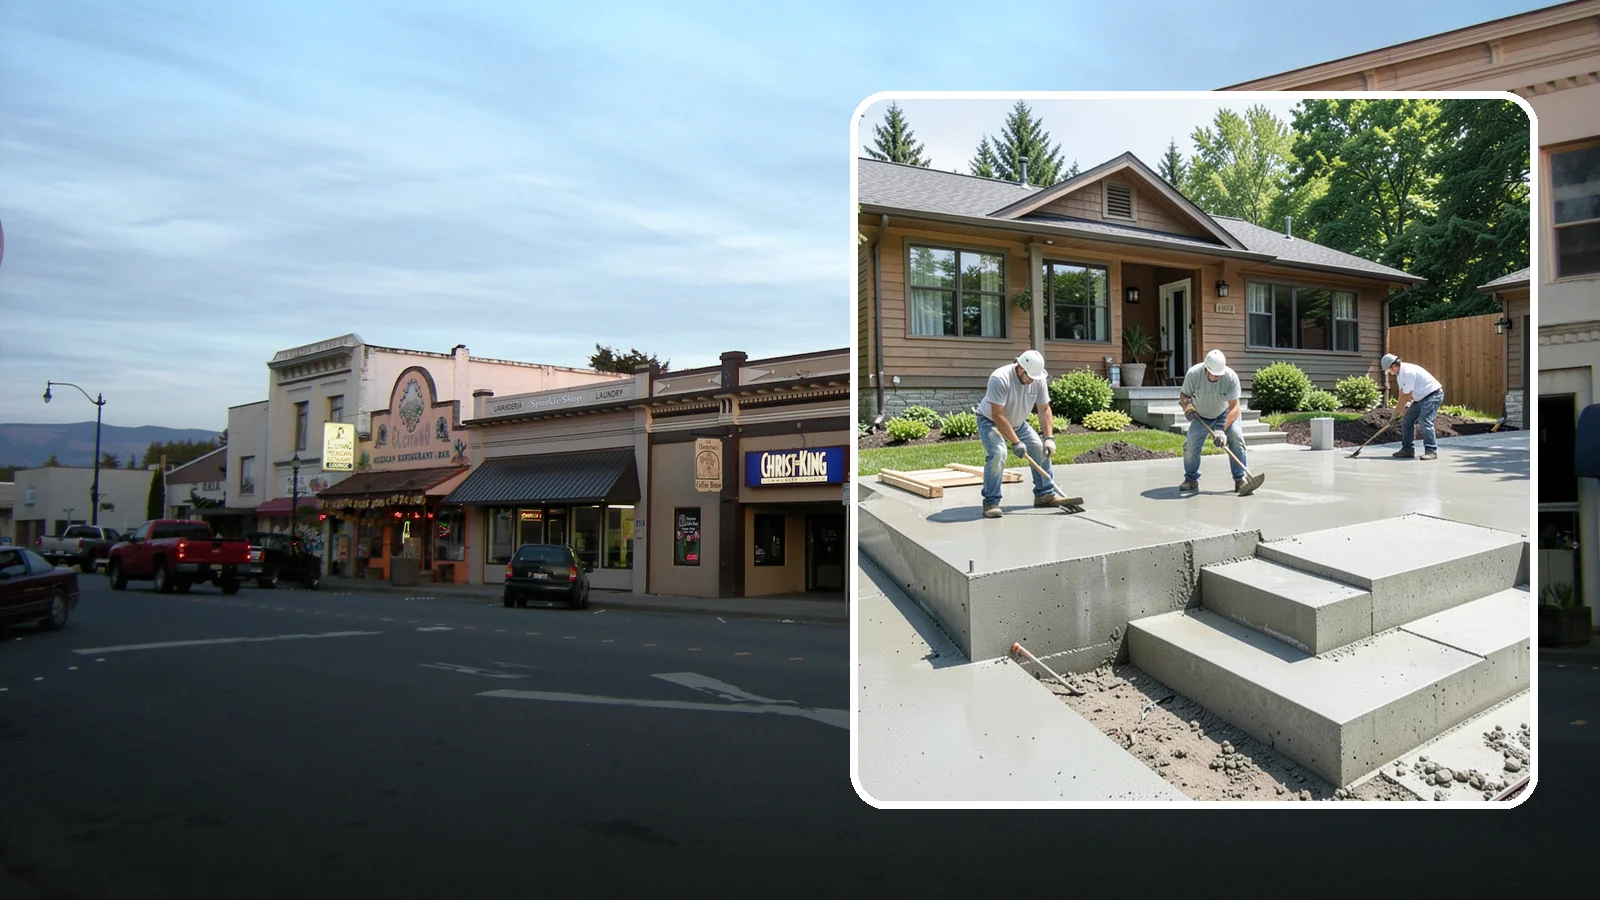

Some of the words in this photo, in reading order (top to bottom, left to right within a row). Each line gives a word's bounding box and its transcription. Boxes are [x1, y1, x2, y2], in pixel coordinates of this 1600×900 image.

[595, 389, 623, 400] LAUNDRY
[493, 401, 523, 413] LAVANDERIA
[530, 397, 561, 409] Sparkle
[562, 394, 582, 406] Shop
[373, 455, 395, 464] MEXICAN
[397, 452, 433, 463] RESTAURANT
[437, 450, 450, 459] BAR
[761, 452, 797, 478] CHRIST
[799, 450, 828, 476] KING
[696, 481, 709, 489] Coffee
